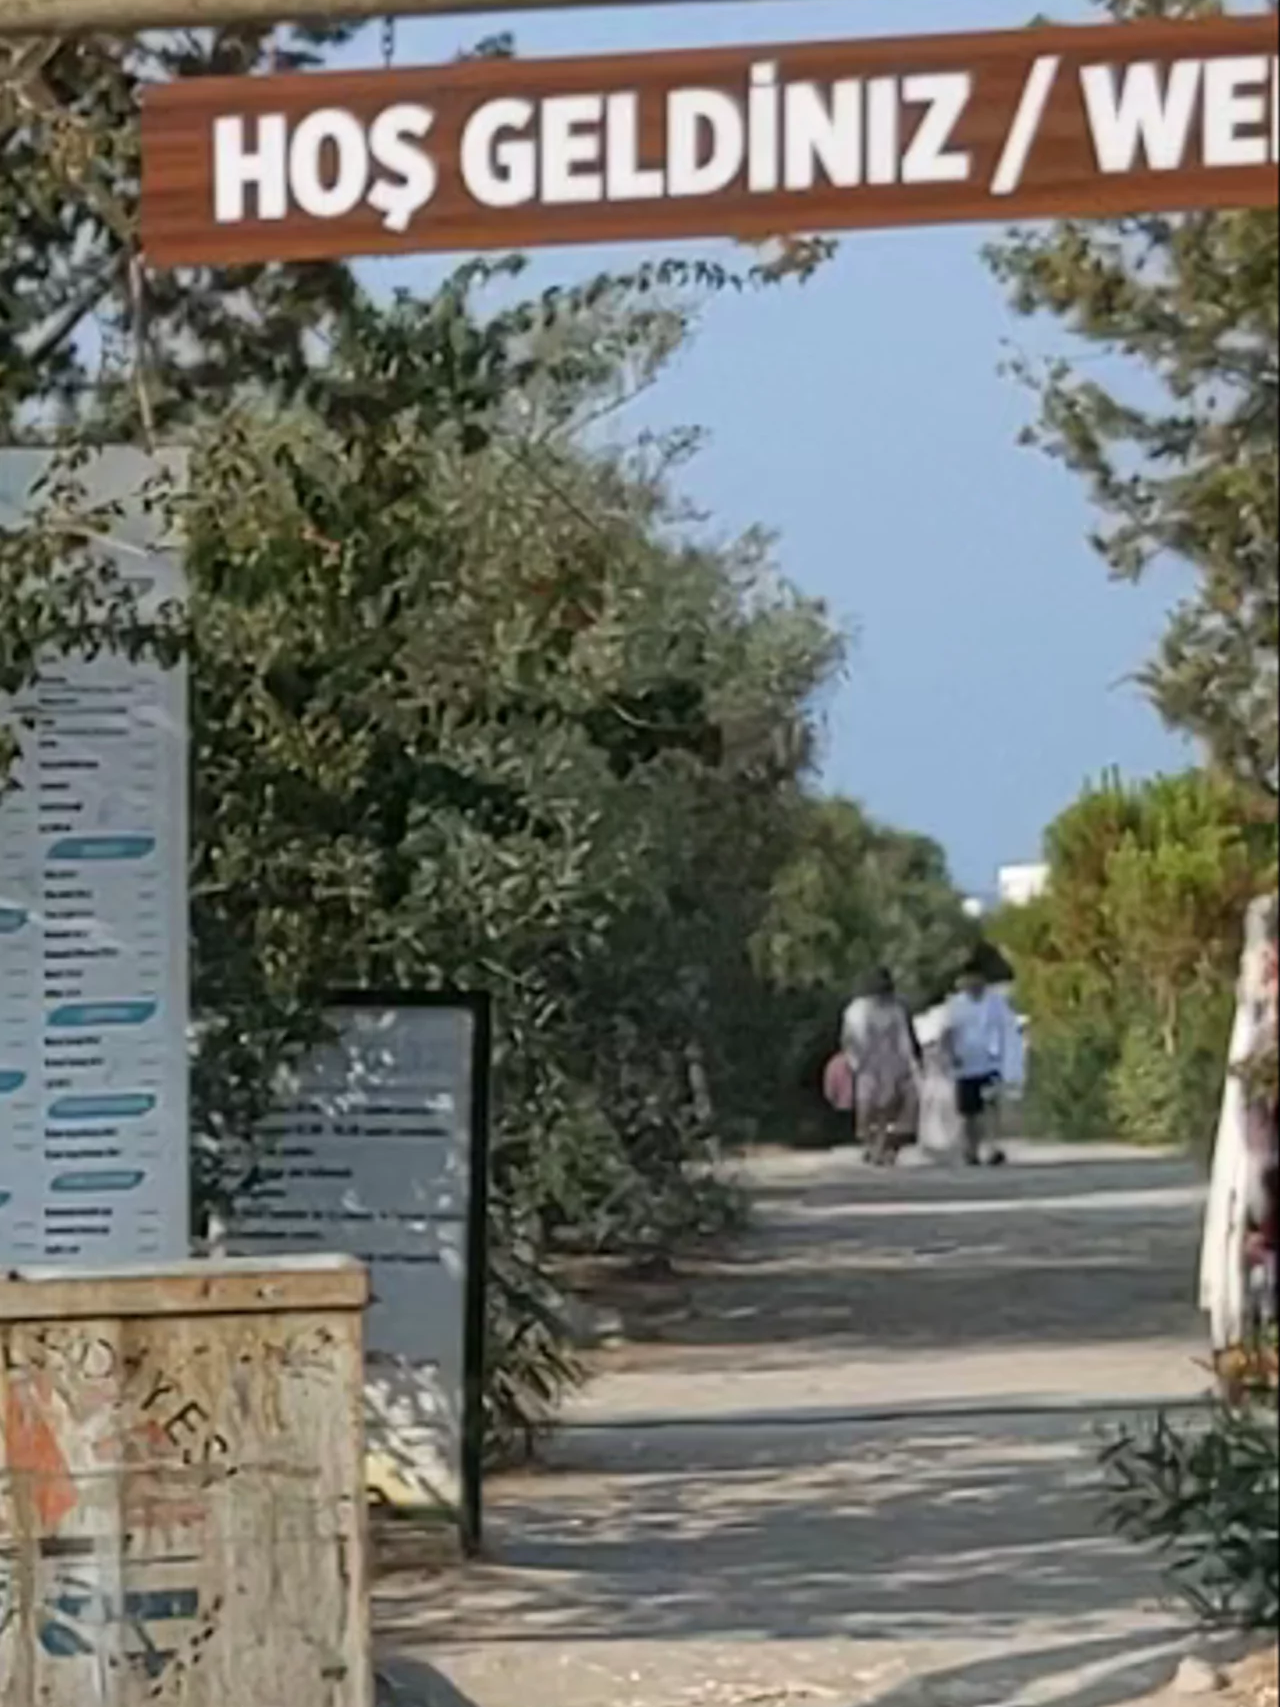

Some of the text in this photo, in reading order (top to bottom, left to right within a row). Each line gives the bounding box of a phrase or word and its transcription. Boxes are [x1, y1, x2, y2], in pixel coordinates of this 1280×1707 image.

[213, 104, 437, 232] HOŞ
[990, 55, 1060, 194] /
[1079, 55, 1278, 173] WE
